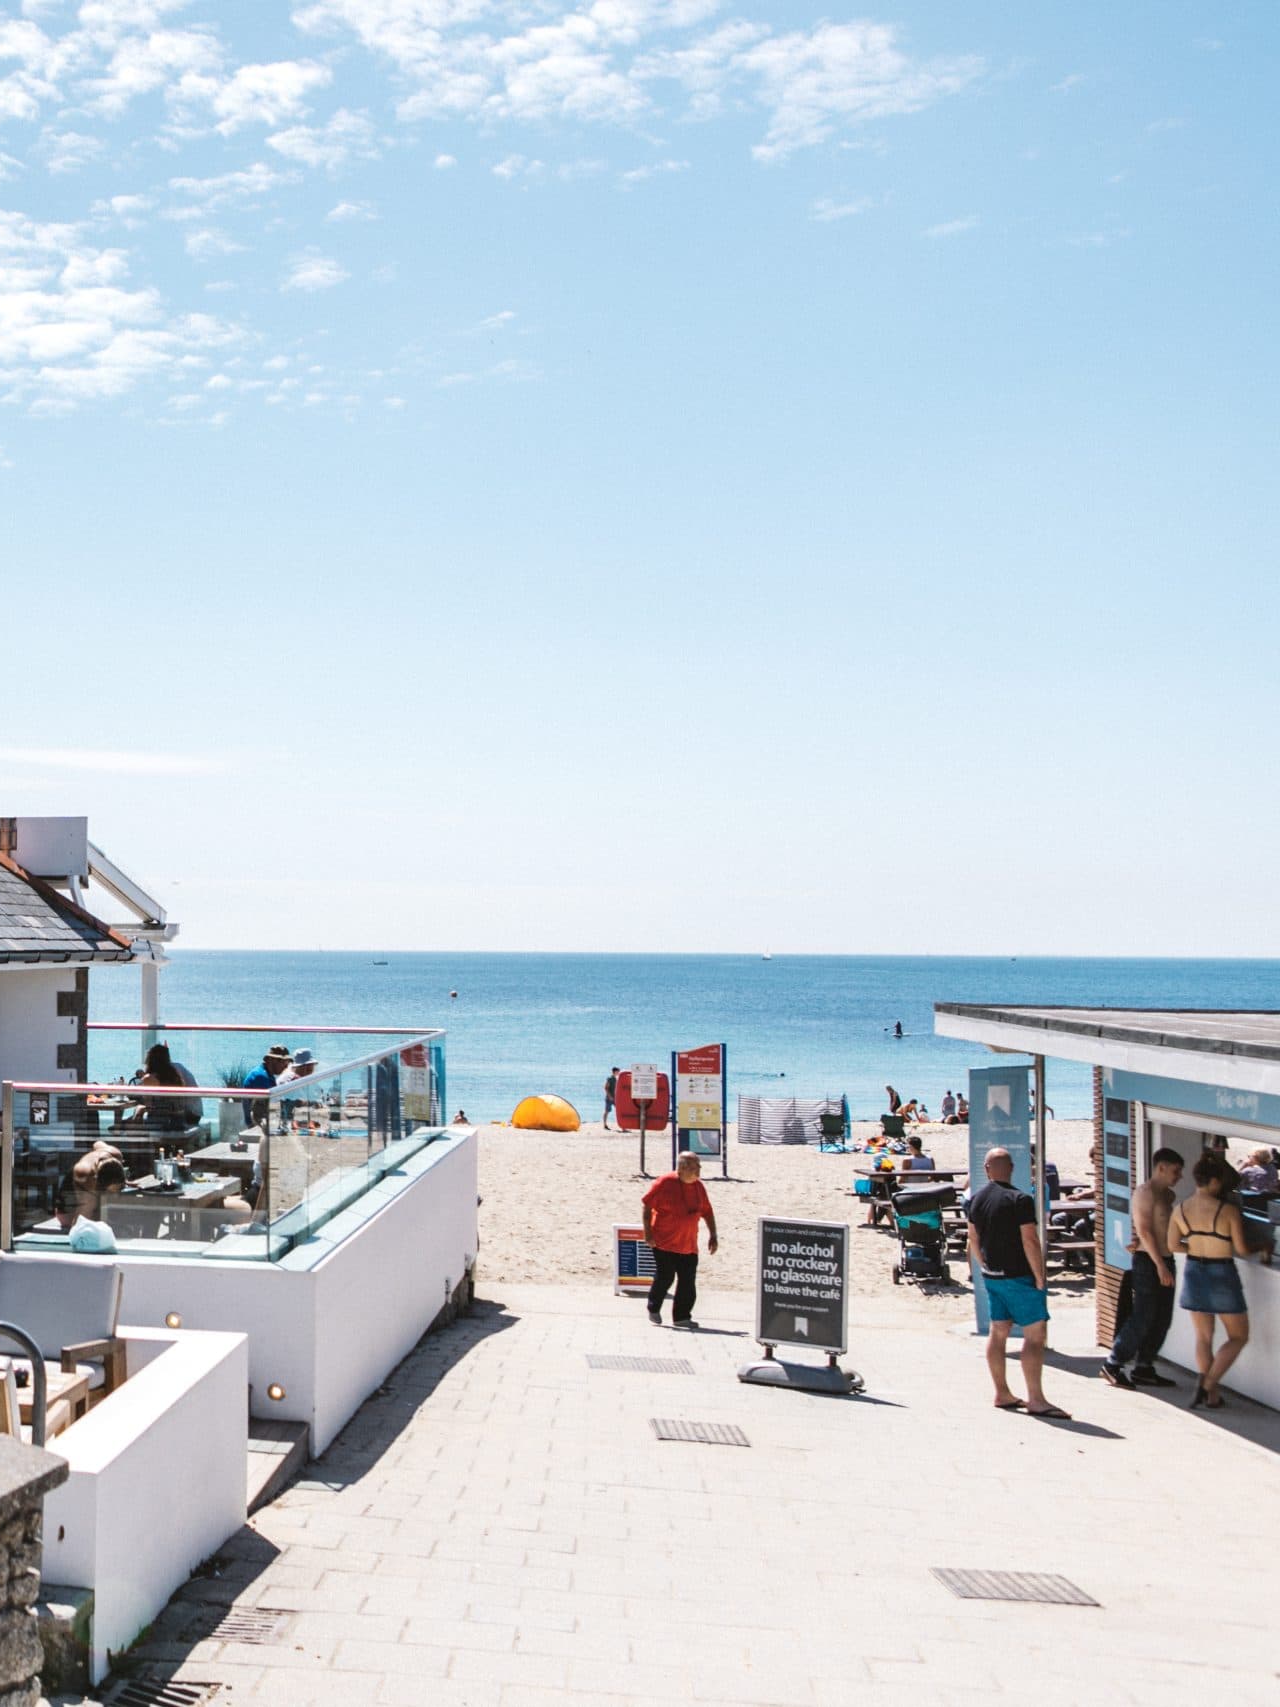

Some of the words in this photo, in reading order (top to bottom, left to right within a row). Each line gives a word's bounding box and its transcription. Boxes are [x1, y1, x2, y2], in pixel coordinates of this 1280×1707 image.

[771, 1242, 788, 1254] no
[789, 1241, 834, 1258] alcohol
[767, 1255, 783, 1267] no
[785, 1257, 838, 1275] crockery
[763, 1268, 779, 1280] no
[780, 1268, 842, 1287] glassware
[764, 1283, 774, 1292] to
[775, 1283, 800, 1296] leave
[802, 1286, 819, 1298] the
[819, 1289, 841, 1300] café
